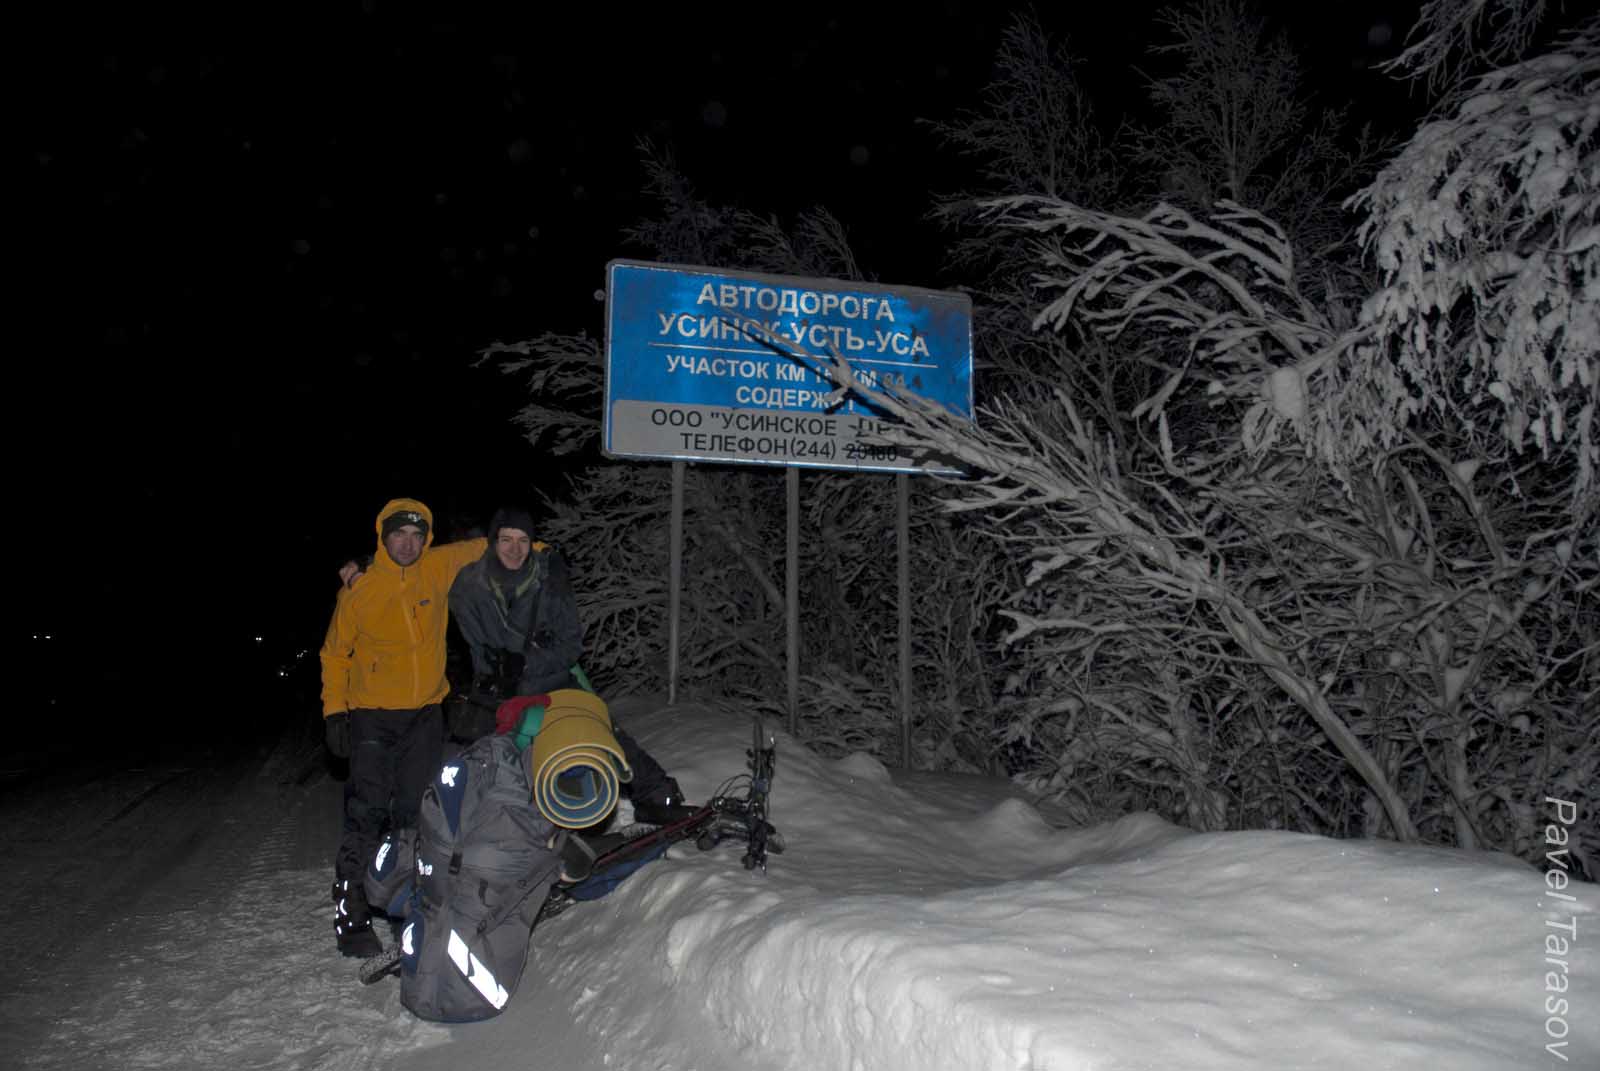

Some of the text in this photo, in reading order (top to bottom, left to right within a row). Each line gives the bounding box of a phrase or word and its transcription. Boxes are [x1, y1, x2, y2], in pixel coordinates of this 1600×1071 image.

[697, 283, 895, 322] АВТОДОРОГА
[658, 312, 929, 357] УСИНСК-УСТЬ-УСА
[666, 354, 770, 380] УЧАСТОК
[776, 362, 806, 383] КМ
[651, 408, 703, 428] ООО
[711, 411, 838, 437] "УСИНСКОЕ
